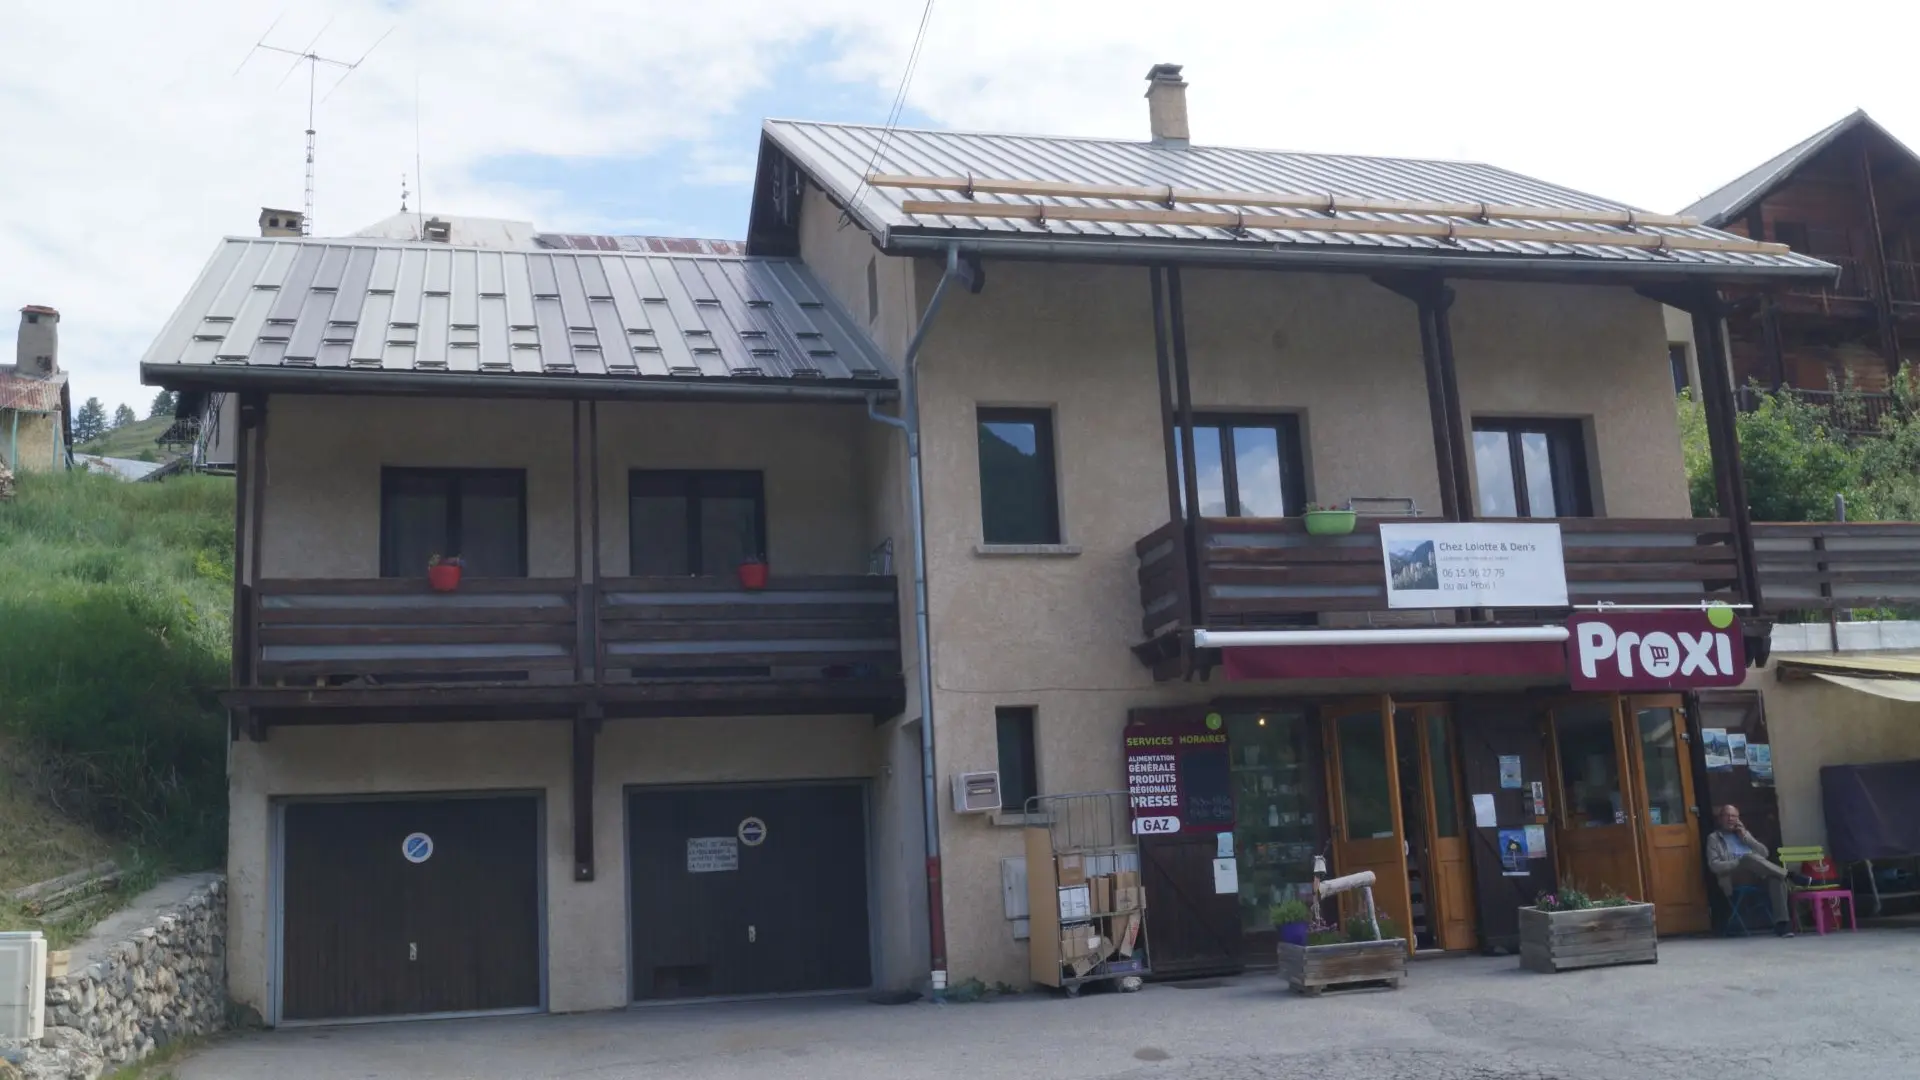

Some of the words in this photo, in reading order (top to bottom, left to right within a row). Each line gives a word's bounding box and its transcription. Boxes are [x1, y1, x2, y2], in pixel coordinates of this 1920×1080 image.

[1439, 542, 1463, 551] Chez
[1500, 542, 1508, 551] &
[1510, 542, 1536, 551] Den's
[1442, 568, 1453, 578] 06
[1456, 568, 1466, 578] 15
[1577, 621, 1734, 678] Proxi
[1127, 736, 1174, 746] SERVICES
[1179, 734, 1227, 744] HORAIRES
[1128, 754, 1175, 762] ALIMENTATION
[1128, 762, 1176, 773] GÉNÉRALE
[1129, 774, 1177, 785] PRODUITS
[1130, 784, 1177, 794] RÉGIONAUX
[1131, 795, 1179, 808] PRESSE
[1143, 819, 1170, 831] GAZ
